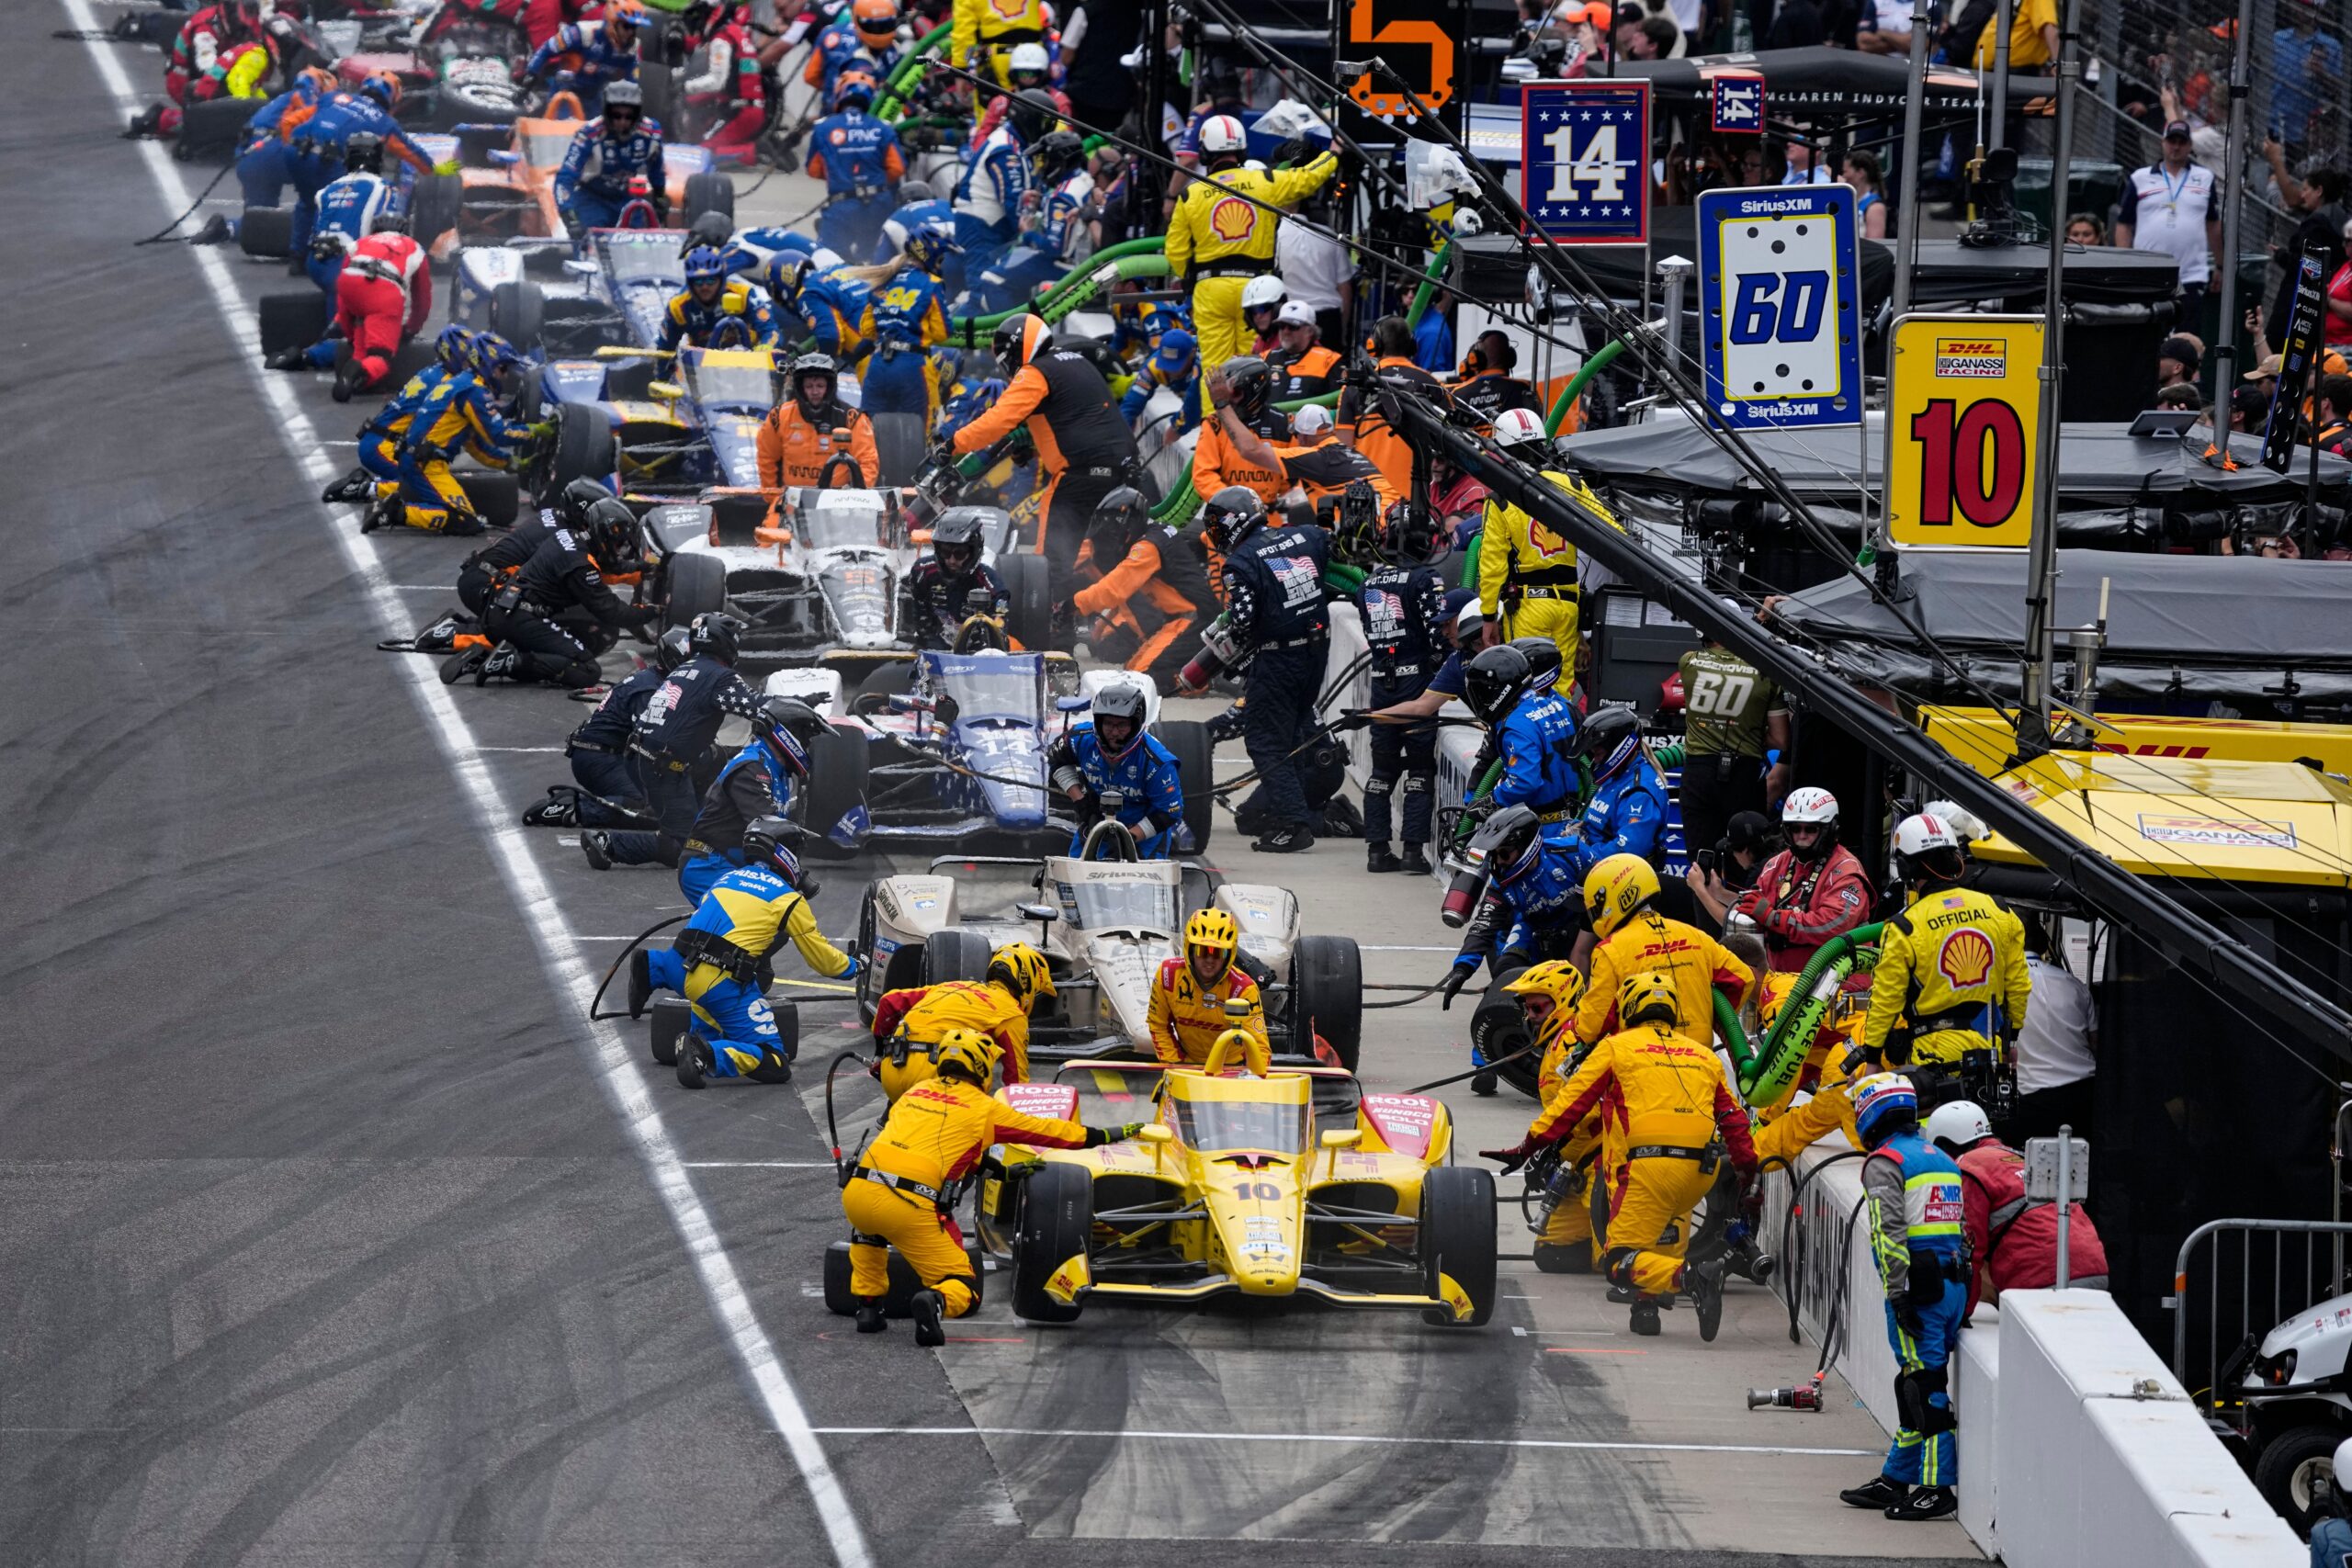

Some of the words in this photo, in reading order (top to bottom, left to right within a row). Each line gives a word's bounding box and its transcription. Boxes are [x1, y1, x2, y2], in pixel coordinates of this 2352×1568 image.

[1350, 0, 1454, 116] 5
[1722, 86, 1754, 121] 14
[1852, 93, 1930, 106] INDYCR
[847, 128, 882, 142] PNC
[1544, 125, 1626, 201] 14
[1741, 198, 1813, 213] SiriusXM
[1729, 269, 1830, 345] 60
[1945, 343, 1998, 354] DHL
[1951, 357, 2004, 369] GANASSI
[1747, 403, 1819, 418] SiriusXM
[1910, 398, 2027, 528] 10
[1228, 525, 1242, 545] Jake
[1690, 658, 1758, 674] ROSENQVIST
[1488, 684, 1512, 712] SiriusXM
[1689, 671, 1755, 717] 60
[1609, 737, 1634, 767] SiriusXM
[2163, 818, 2271, 831] DHL
[2173, 829, 2290, 842] GANASSI
[1086, 871, 1162, 881] SiriusXM
[1611, 866, 1633, 886] DHL
[1927, 908, 1991, 931] OFFICIAL
[1640, 939, 1697, 956] DHL
[1643, 1043, 1702, 1057] DHL
[1774, 1052, 1806, 1086] FUEL
[1010, 1086, 1071, 1095] Root
[1012, 1098, 1072, 1107] SUNOCO
[1014, 1104, 1067, 1112] SOLO
[1367, 1096, 1430, 1108] Root
[1373, 1107, 1432, 1119] SUNOCO
[1378, 1114, 1429, 1126] SOLO
[1233, 1182, 1282, 1201] 10
[1929, 1185, 1962, 1203] AMR
